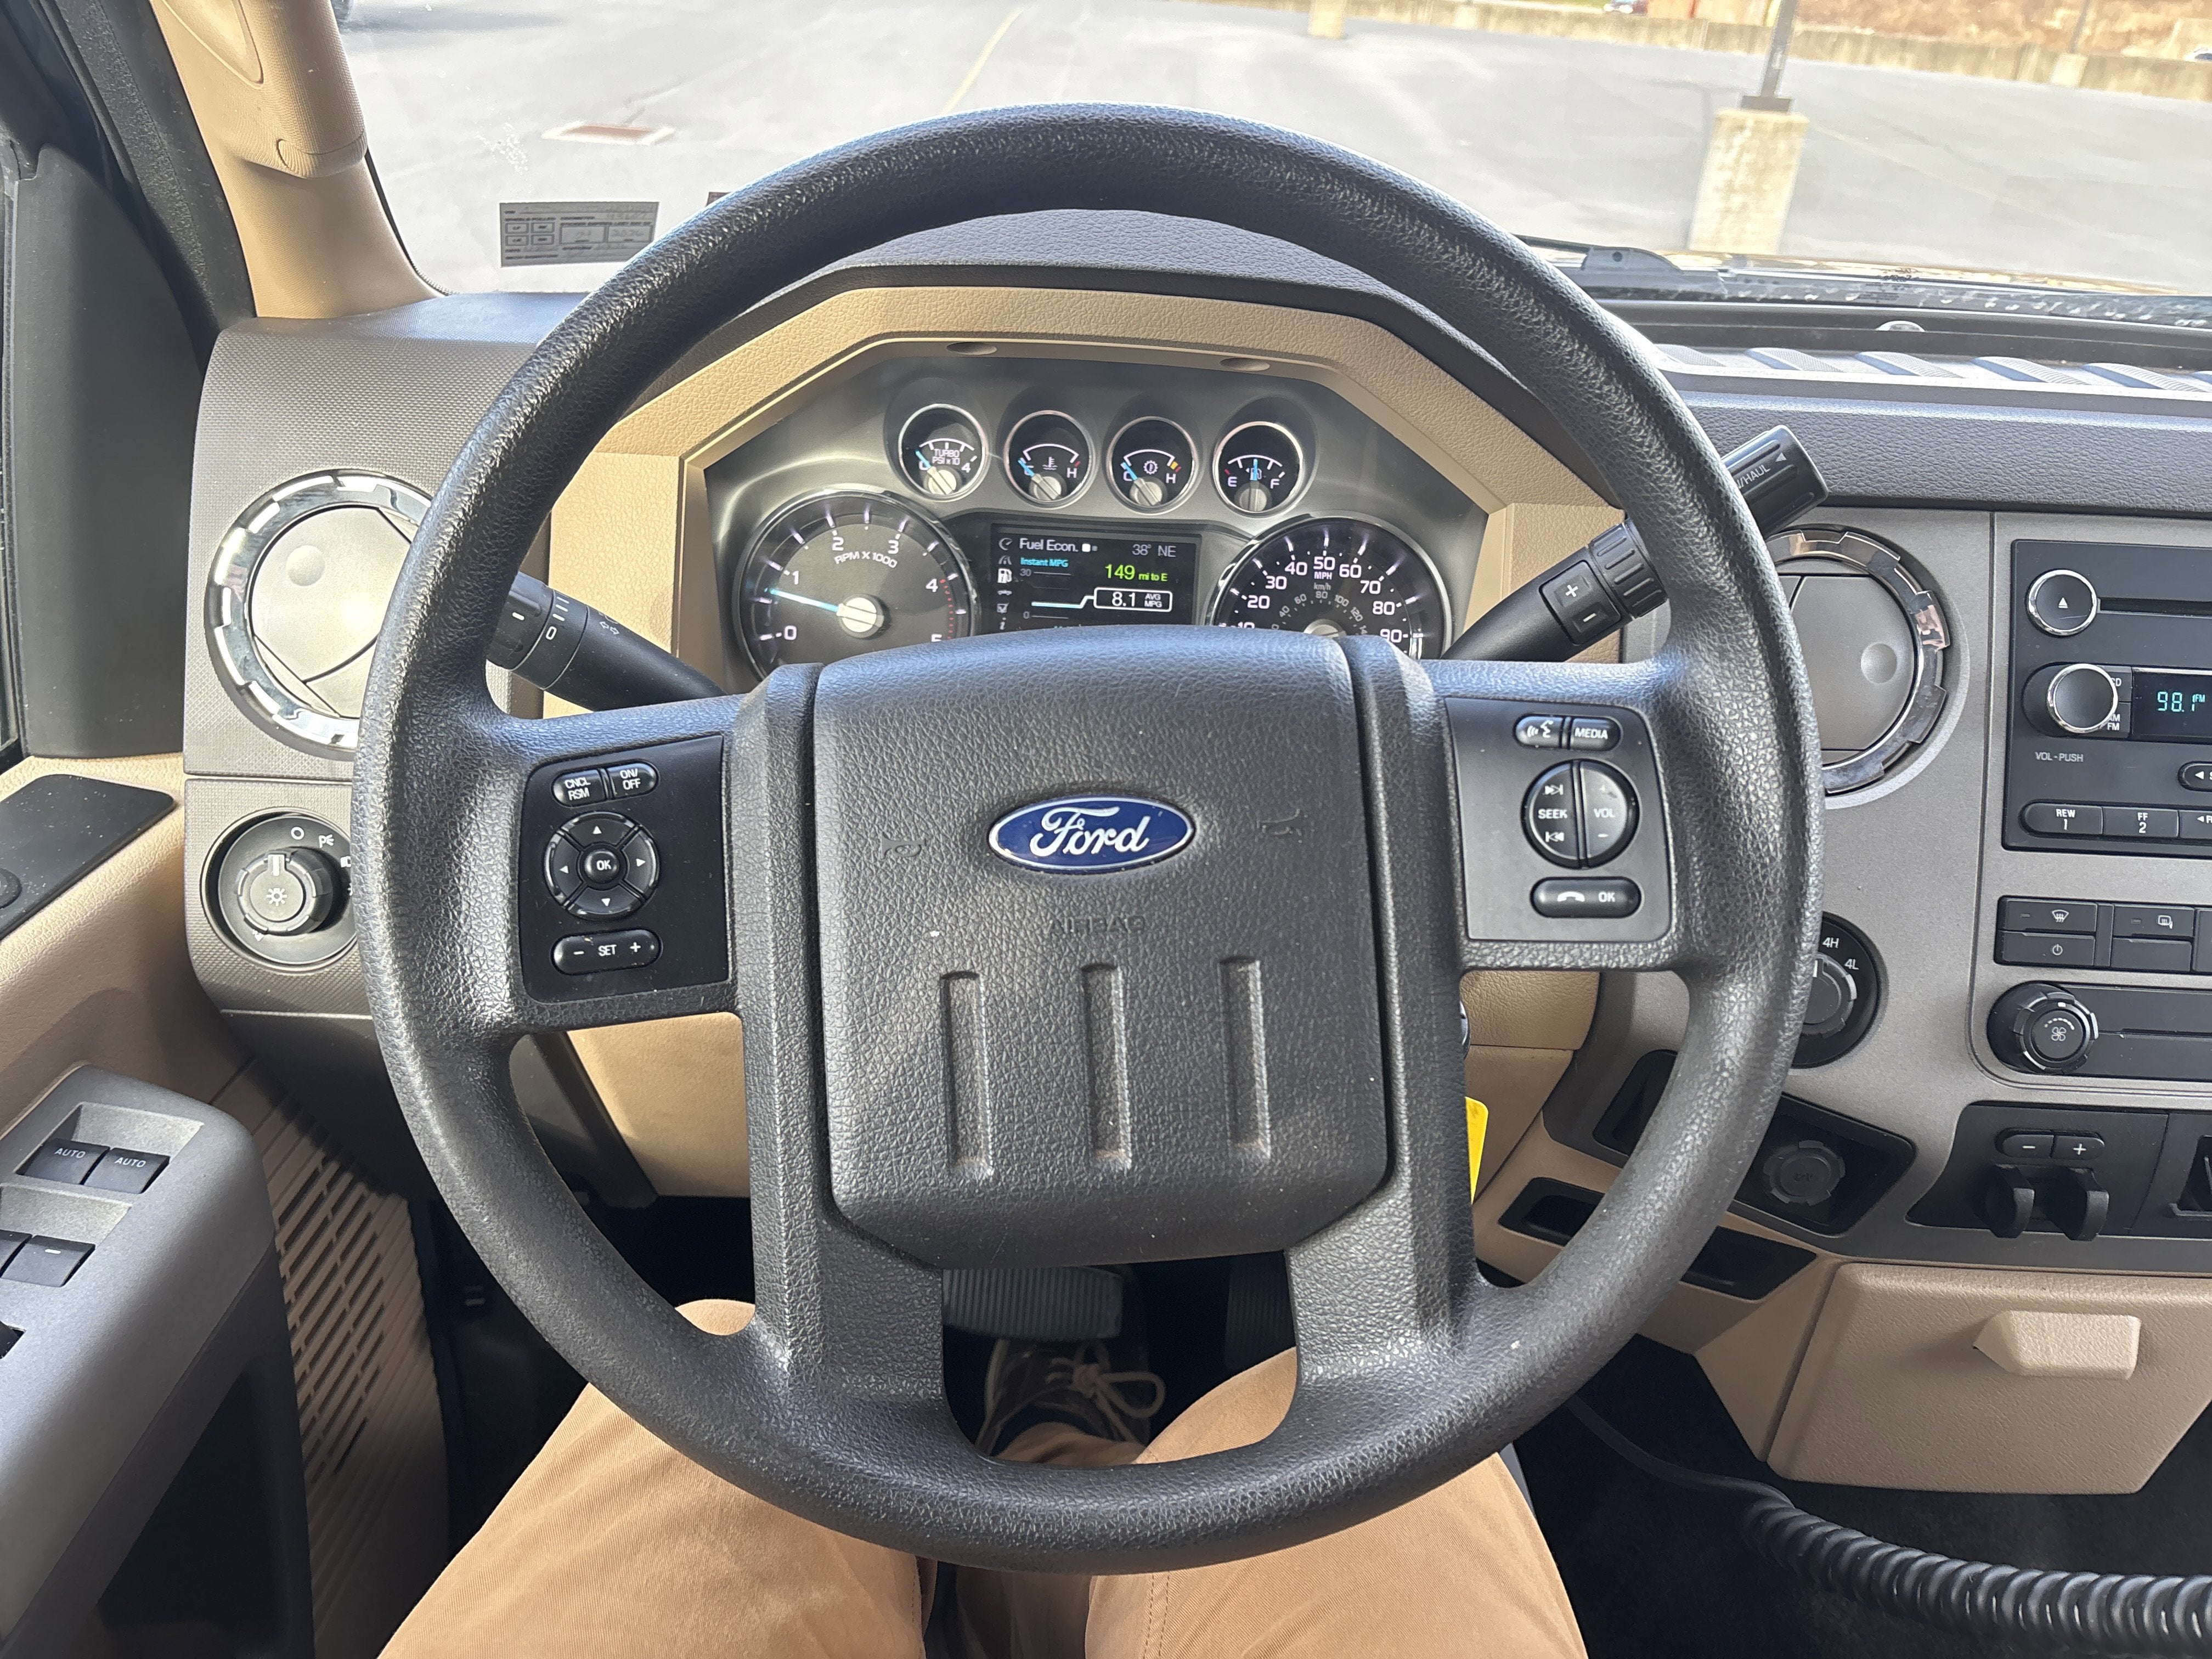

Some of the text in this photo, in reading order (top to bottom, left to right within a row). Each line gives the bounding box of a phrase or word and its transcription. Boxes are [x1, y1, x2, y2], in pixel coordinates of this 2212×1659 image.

[934, 449, 960, 458] TURBO
[961, 463, 970, 473] 4
[1067, 468, 1077, 478] H
[1166, 473, 1176, 483] H
[1228, 476, 1238, 487] E
[1271, 479, 1279, 489] F
[832, 537, 844, 551] 2
[888, 540, 899, 554] 3
[1019, 538, 1079, 553] Fuel Econ.
[1158, 545, 1176, 558] NE
[834, 551, 860, 565] RPM
[872, 553, 898, 568] 1000
[1020, 557, 1069, 568] Instant MPG
[1313, 556, 1335, 571] 50
[1020, 568, 1032, 577] 30
[1105, 564, 1136, 581] 149
[1161, 573, 1168, 582] E
[1284, 561, 1308, 576] 40
[1339, 564, 1362, 578] 60
[792, 571, 799, 585] 1
[1314, 571, 1333, 580] MPH
[926, 578, 938, 592] 4
[1265, 575, 1287, 590] 30
[1313, 582, 1331, 591] km/h
[1360, 579, 1381, 595] 70
[1111, 591, 1136, 607] 8.1
[1294, 594, 1307, 605] 60
[1316, 591, 1328, 600] 80
[1334, 594, 1350, 607] 100
[1144, 600, 1162, 608] MPG
[1247, 595, 1270, 610] 20
[1372, 601, 1395, 616] 80
[1023, 611, 1030, 619] 0
[1278, 605, 1290, 618] 40
[1350, 606, 1363, 622] 120
[784, 625, 797, 640] 0
[1380, 629, 1402, 643] 90
[2107, 723, 2120, 731] FM
[1575, 727, 1609, 740] MEDIA
[564, 777, 591, 789] CNCL
[622, 778, 641, 791] OFF
[568, 788, 590, 801] RSM
[1538, 808, 1568, 819] SEEK
[1594, 808, 1616, 818] VOL
[2056, 809, 2075, 818] REW
[2137, 812, 2148, 821] FF
[2063, 819, 2068, 830] 1
[2138, 822, 2146, 833] 2
[1029, 806, 1151, 857] Ford
[596, 859, 612, 871] OK
[1598, 891, 1616, 902] OK
[1822, 937, 1839, 949] 4H
[598, 944, 617, 957] SET
[1844, 958, 1859, 970] 4L
[54, 1148, 86, 1159] AUTO
[115, 1156, 146, 1168] AUTO
